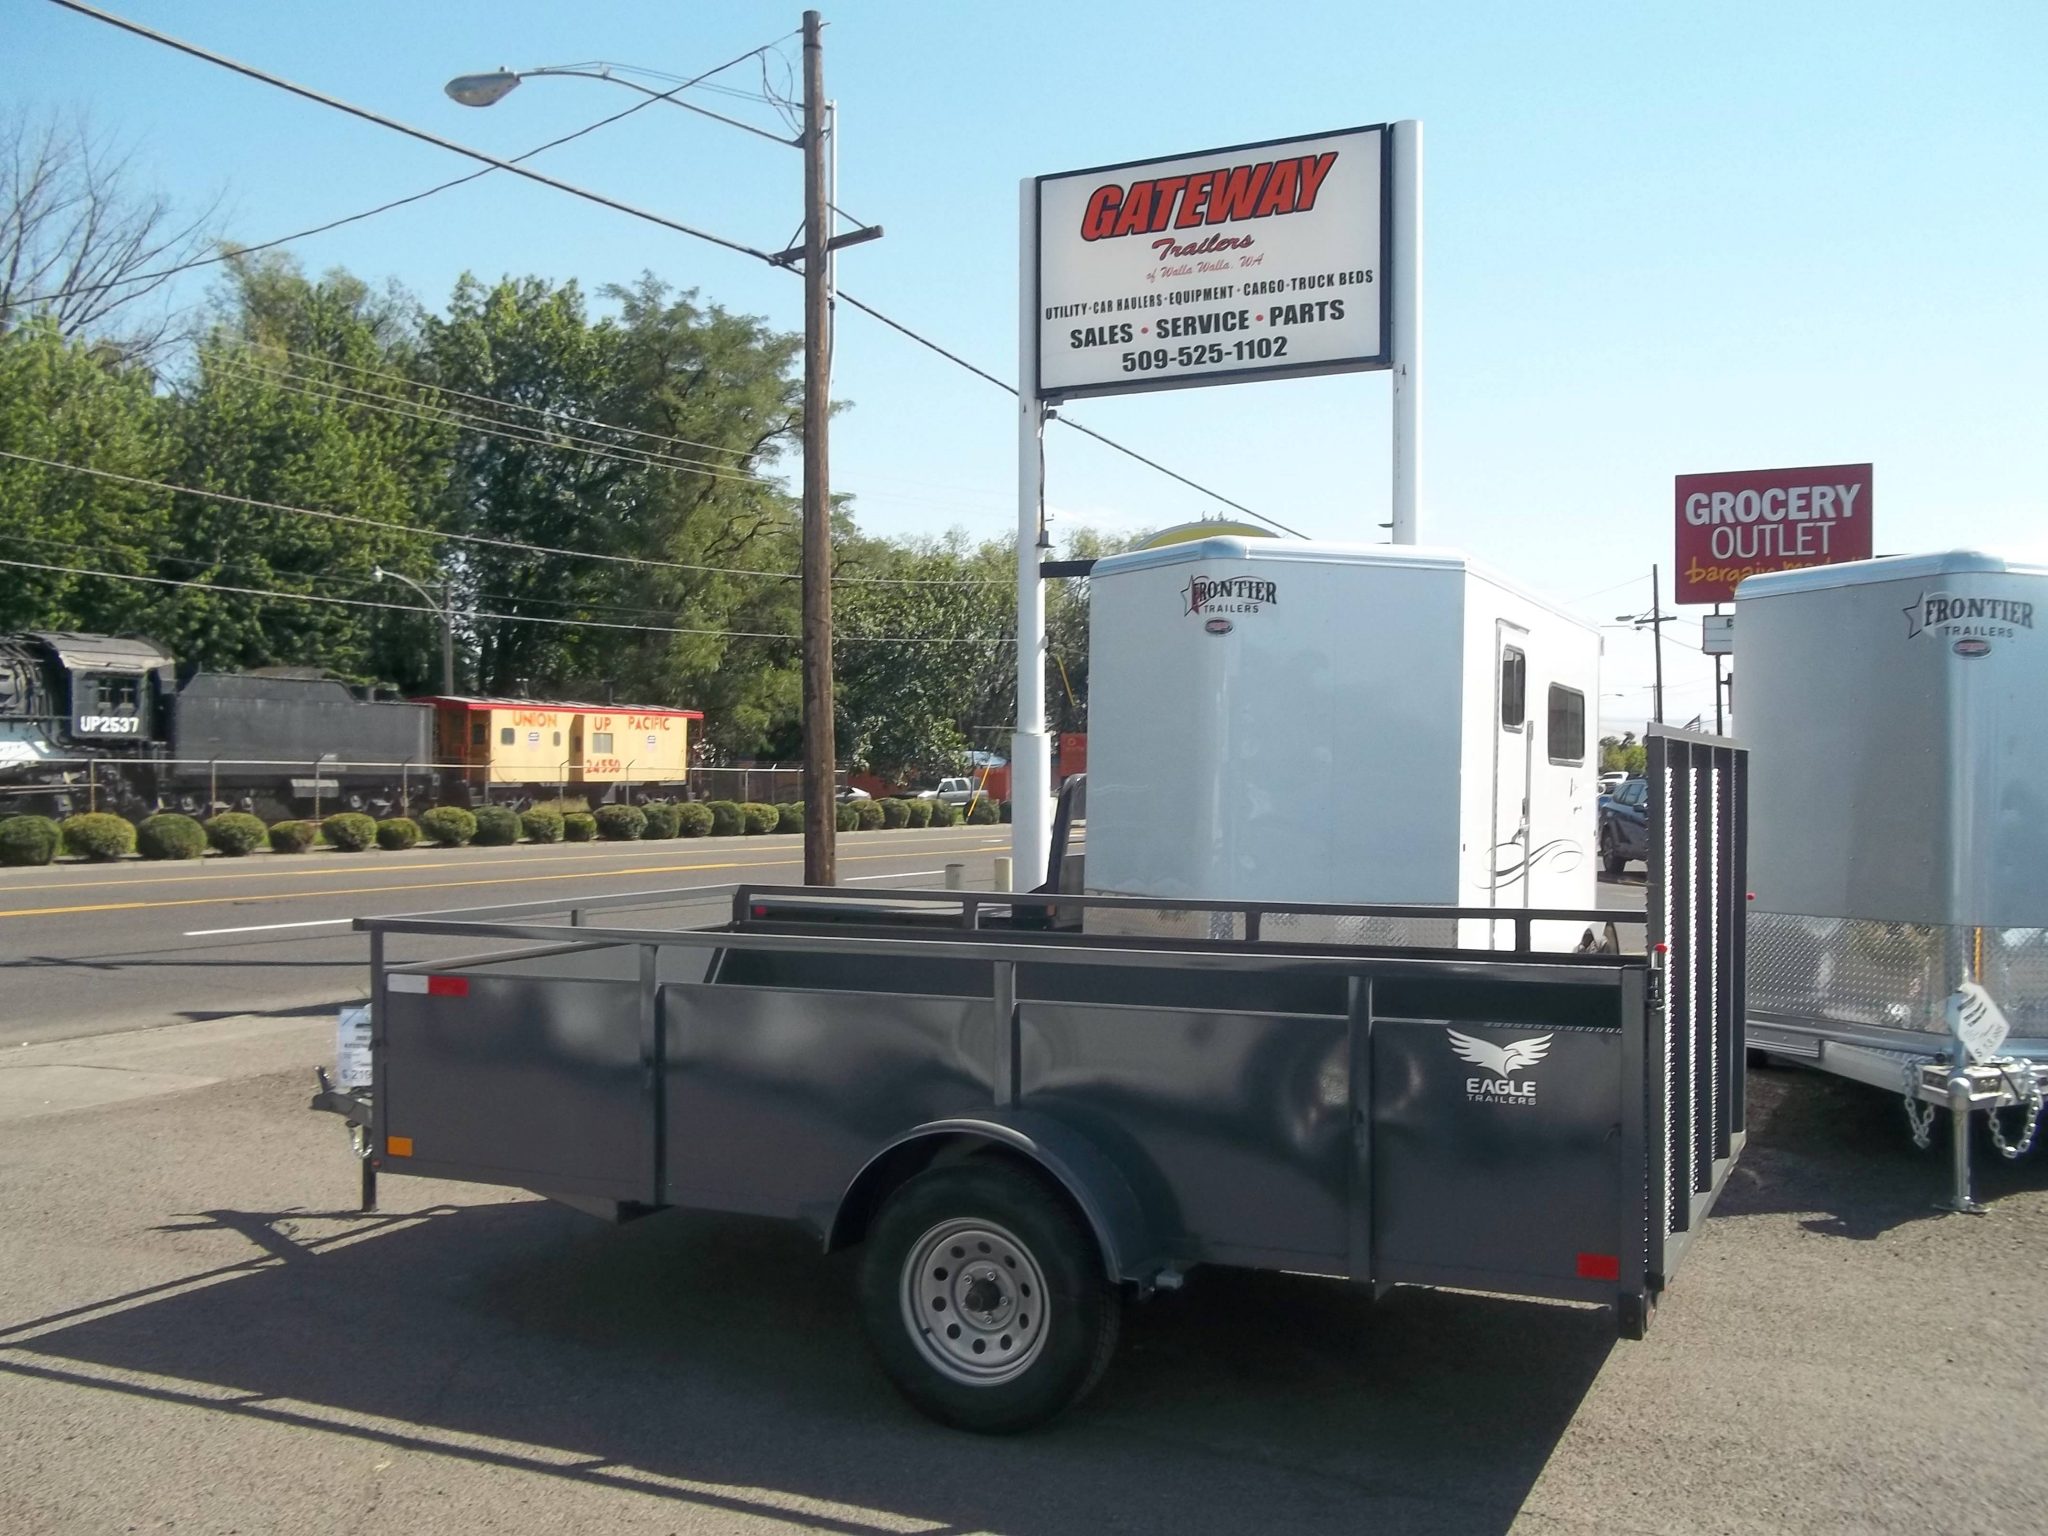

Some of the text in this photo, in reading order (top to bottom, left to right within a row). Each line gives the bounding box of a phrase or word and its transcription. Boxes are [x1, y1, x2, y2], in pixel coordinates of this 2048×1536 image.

[1081, 151, 1339, 242] GATEWAY
[1152, 233, 1255, 262] Trailers
[1146, 268, 1158, 284] of
[1160, 264, 1193, 278] Walla
[1240, 253, 1265, 268] WA
[1116, 293, 1163, 312] HAULERS
[1169, 285, 1234, 306] EQUIPMENT
[1291, 273, 1336, 291] TRUCK
[1339, 269, 1374, 287] BEDS
[1070, 299, 1346, 349] SALES SERVICE PARTS
[1122, 336, 1288, 373] 509-525-1102
[1685, 483, 1862, 526] GROCERY
[1711, 521, 1837, 560] OUTLET
[1684, 556, 1777, 592] barga
[1191, 580, 1278, 607] FRONTIER
[1203, 604, 1260, 614] TRAILERS
[1923, 598, 2035, 630] FRONTIER
[1944, 625, 2015, 639] TRAILERS
[80, 715, 140, 733] UP2537
[512, 711, 671, 731] UNION UP PACIFIC
[1466, 1077, 1537, 1097] EAGLE
[1466, 1093, 1537, 1106] TRAILERS
